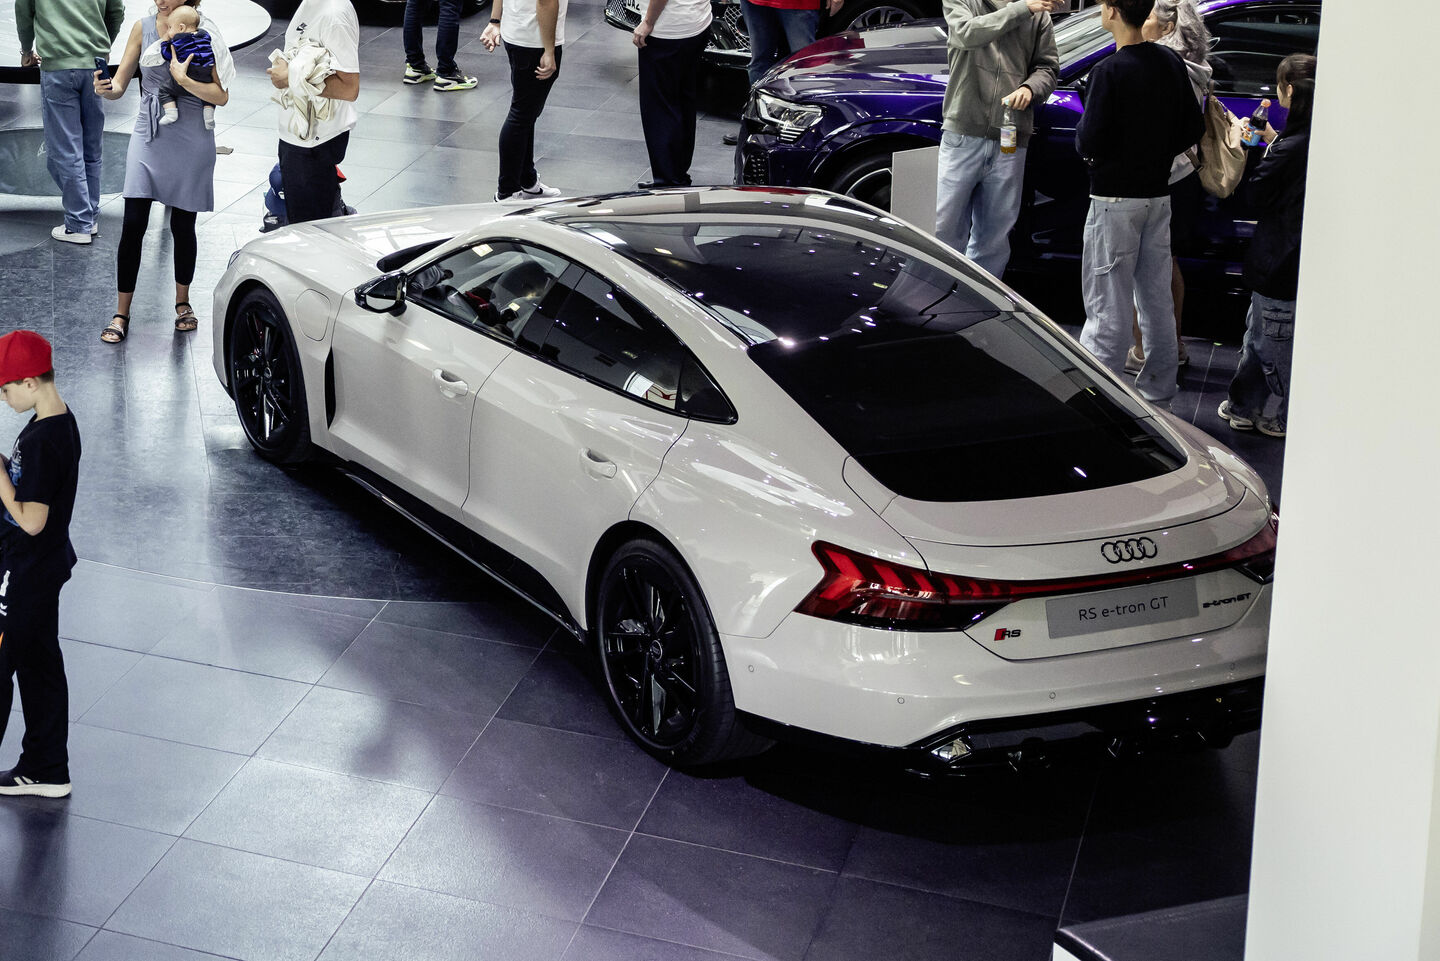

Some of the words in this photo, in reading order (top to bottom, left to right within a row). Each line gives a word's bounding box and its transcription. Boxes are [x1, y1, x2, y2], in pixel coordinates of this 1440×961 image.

[1078, 607, 1097, 621] RS
[1101, 601, 1146, 617] e-tron
[1150, 596, 1169, 610] GT
[1001, 628, 1022, 639] RS
